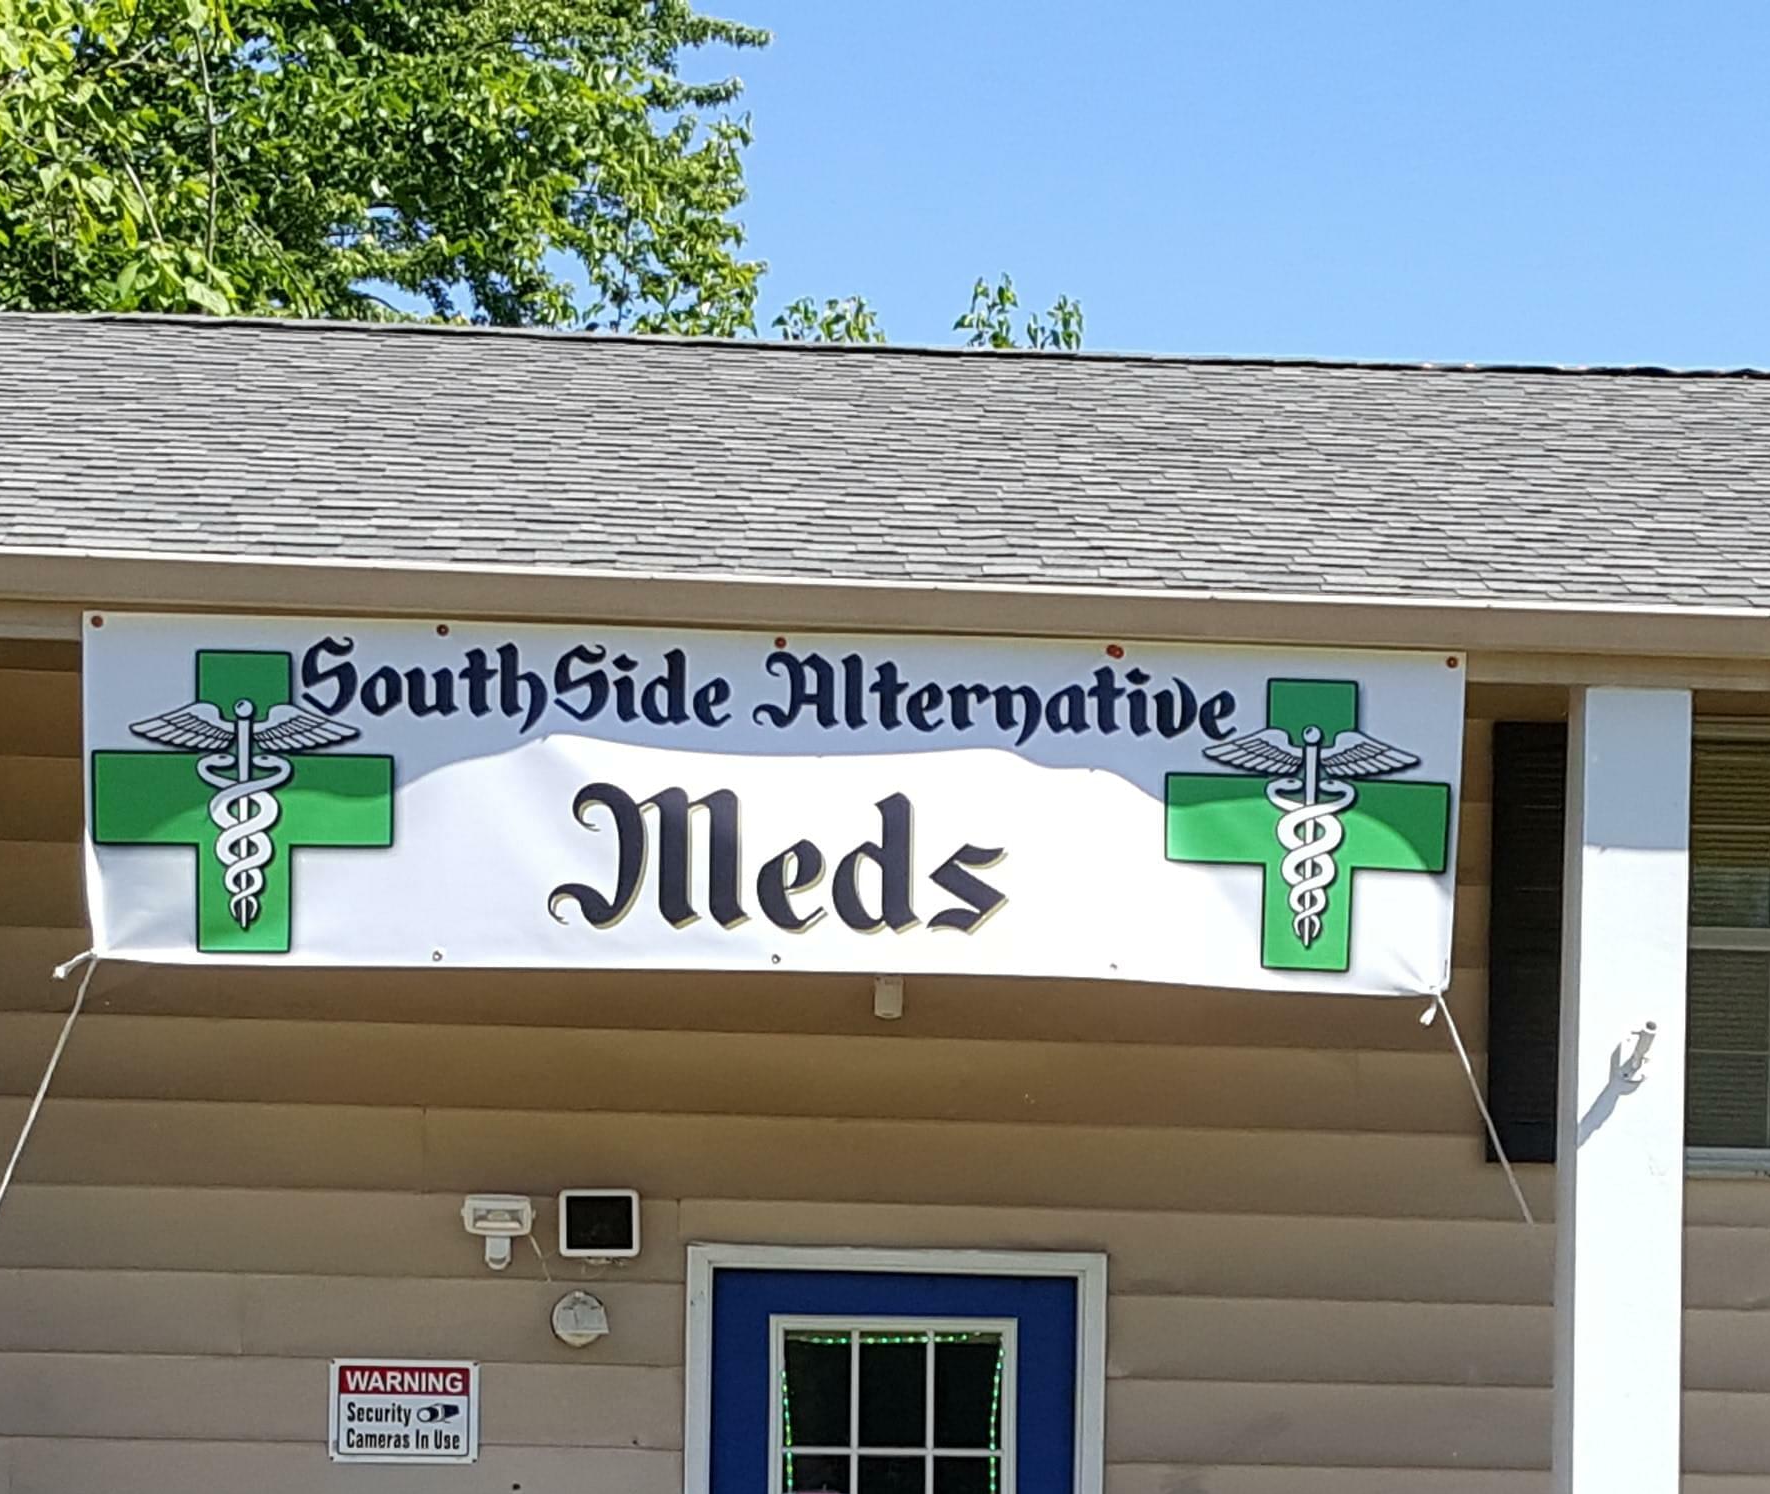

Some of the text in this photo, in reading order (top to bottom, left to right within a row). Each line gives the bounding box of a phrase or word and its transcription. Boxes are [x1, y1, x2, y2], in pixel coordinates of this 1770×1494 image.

[752, 651, 1236, 747] Alternative
[548, 782, 1009, 935] Meds
[345, 1370, 464, 1393] WARNING
[347, 1401, 412, 1427] Security
[346, 1427, 461, 1450] Cameras In Use
